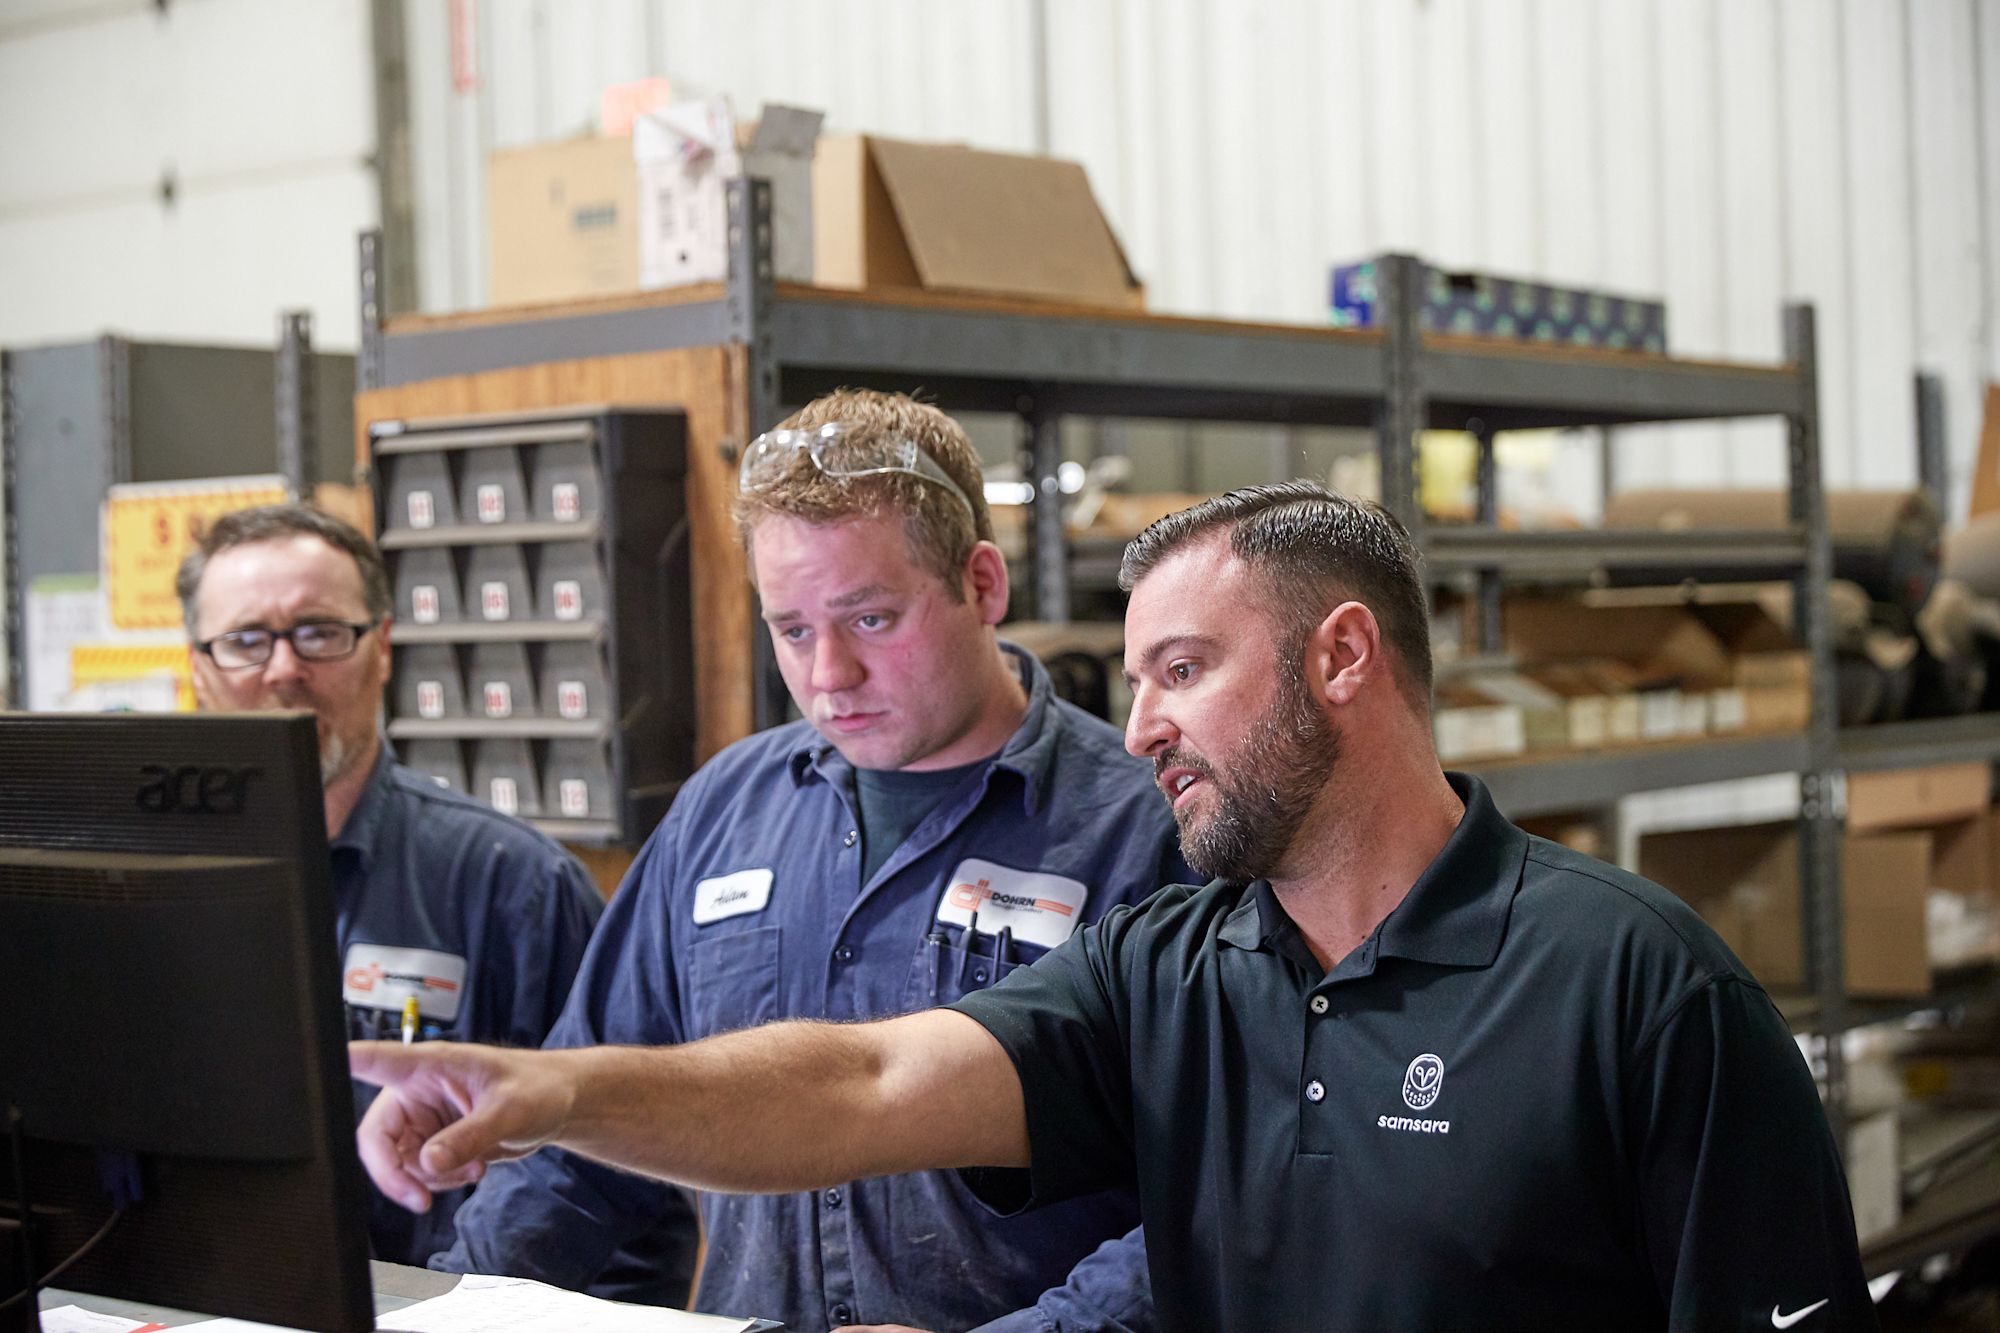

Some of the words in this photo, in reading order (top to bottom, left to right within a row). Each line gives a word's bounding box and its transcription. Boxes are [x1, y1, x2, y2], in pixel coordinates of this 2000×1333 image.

[136, 764, 261, 815] acer
[991, 892, 1036, 906] DOHRN
[1377, 1115, 1450, 1133] samsara
